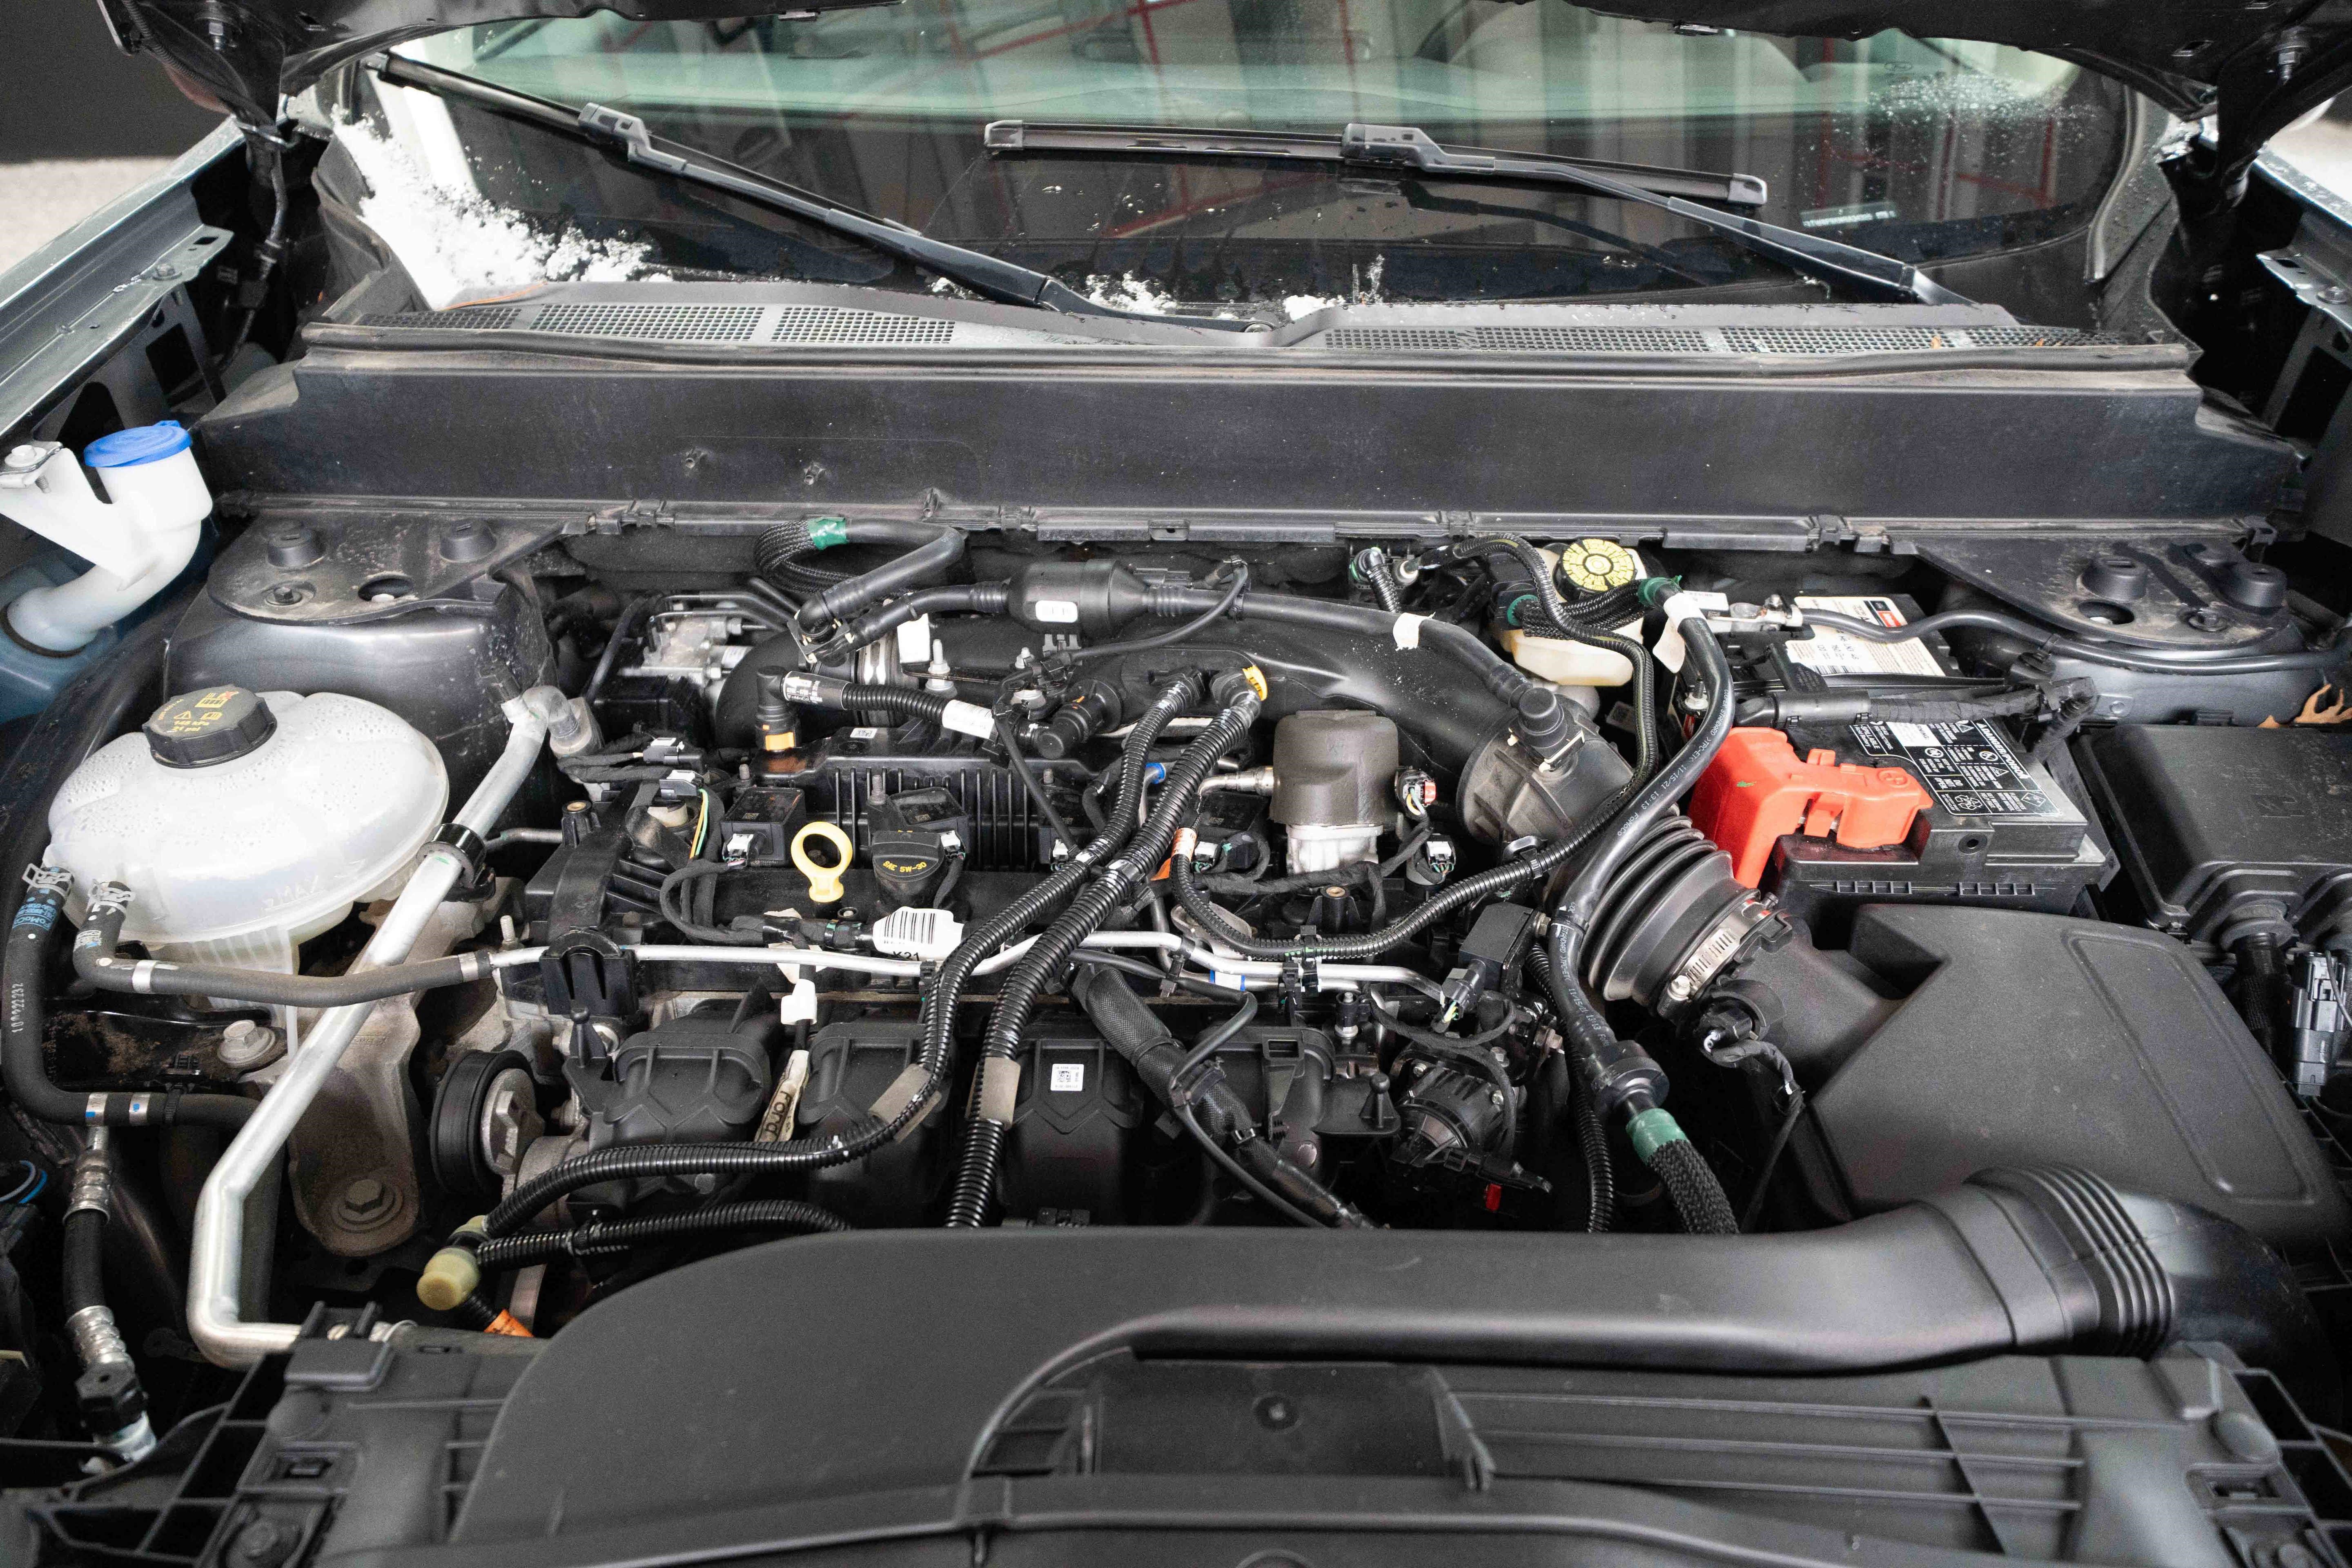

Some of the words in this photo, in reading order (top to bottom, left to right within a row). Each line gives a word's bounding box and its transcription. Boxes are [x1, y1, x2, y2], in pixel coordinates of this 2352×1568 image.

[1711, 709, 1726, 736] STANDARD
[1878, 725, 1890, 735] READ
[1872, 725, 1895, 750] INSTRUCTIONS.
[1661, 764, 1686, 790] 11/15/21
[1943, 779, 1956, 787] NOT
[1641, 790, 1659, 810] 13:13
[1617, 812, 1639, 836] FoMoCo
[882, 860, 898, 871] SAE
[900, 862, 927, 873] 5W-30
[893, 951, 920, 962] K21
[1559, 926, 1569, 953] STANDARD
[1568, 988, 1589, 1014] 11/15/21
[1586, 1015, 1601, 1030] 13:13
[766, 1091, 792, 1136] Ford
